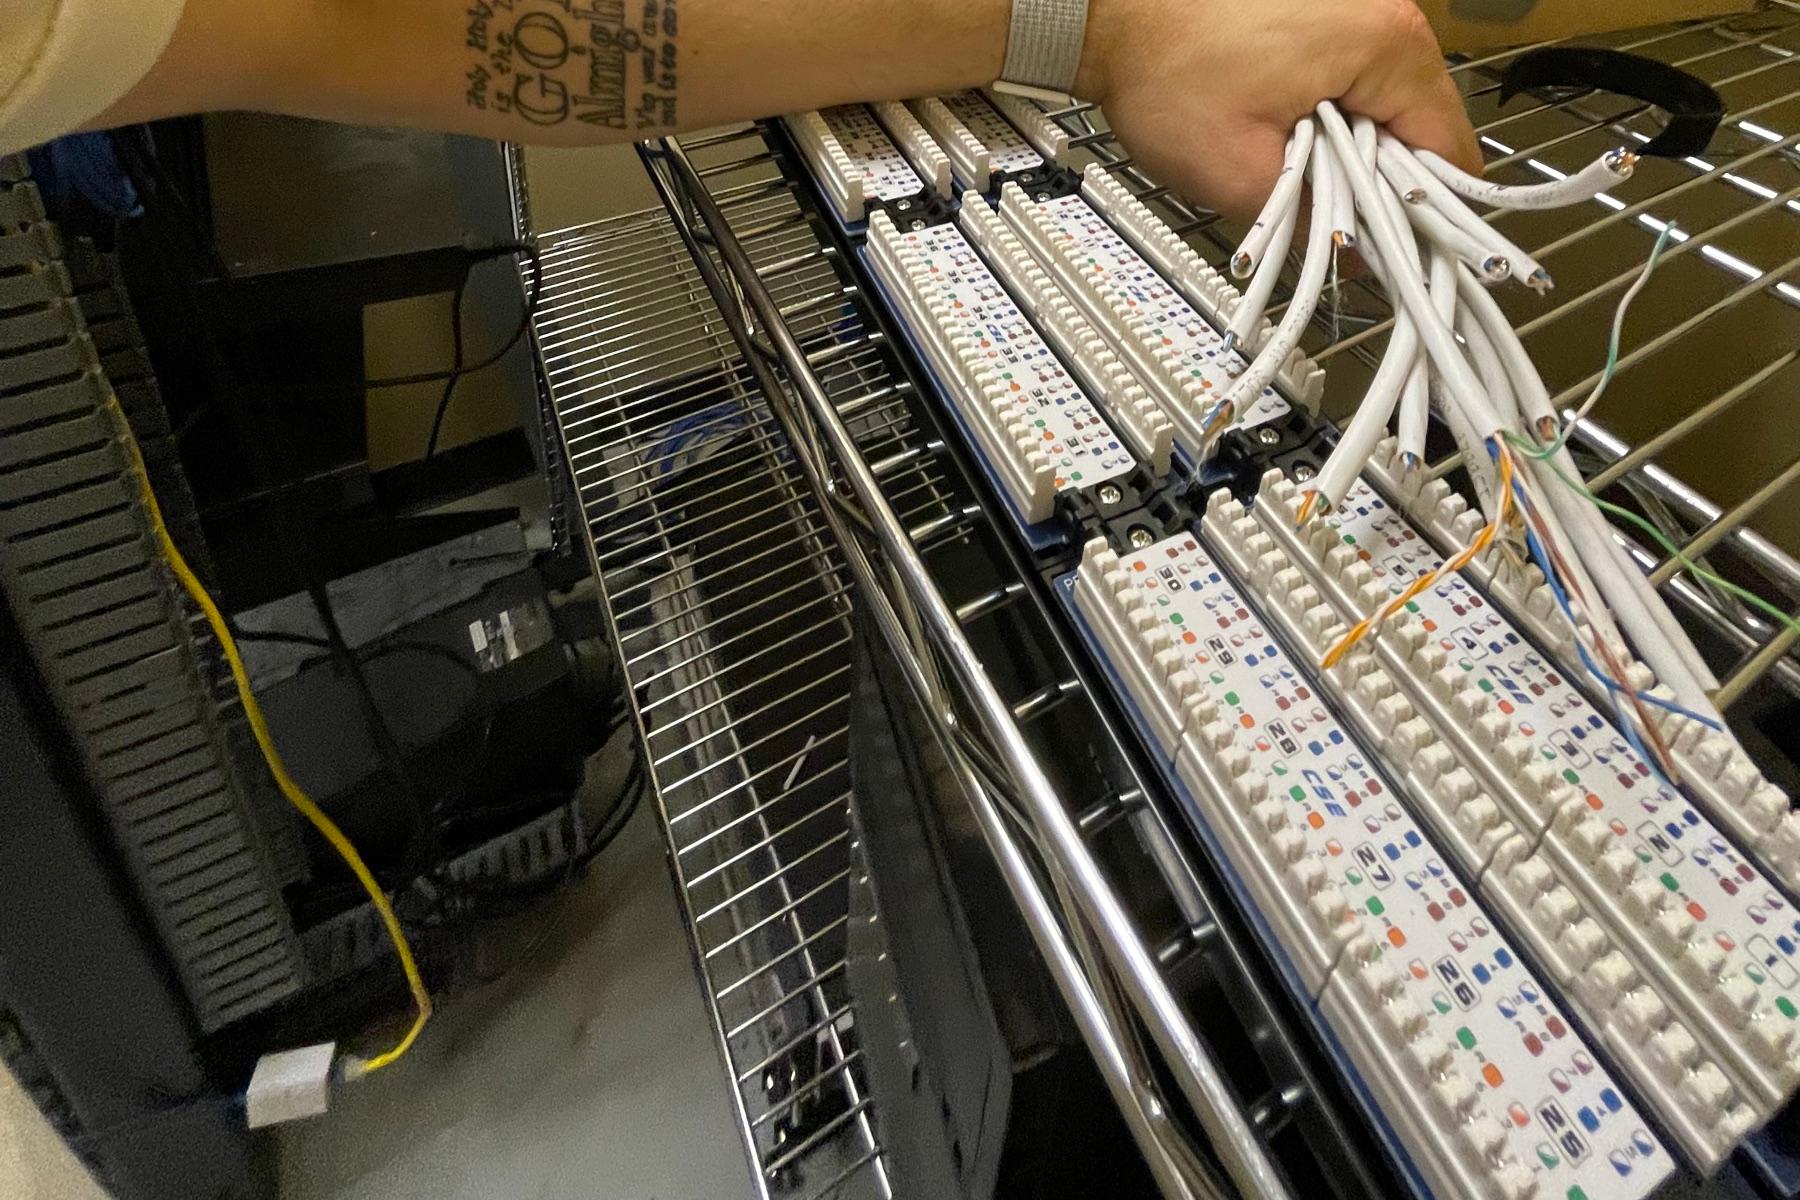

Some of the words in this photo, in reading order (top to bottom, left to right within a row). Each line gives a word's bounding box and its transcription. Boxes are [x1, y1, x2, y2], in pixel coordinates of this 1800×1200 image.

[490, 31, 515, 75] the
[466, 63, 492, 110] Holy
[491, 92, 513, 113] is
[1032, 388, 1050, 407] 32
[1159, 566, 1183, 592] 30
[1208, 637, 1234, 665] 29
[1267, 721, 1297, 755] 28
[1356, 845, 1391, 887] 27
[1437, 959, 1475, 1007] 26
[1540, 1103, 1585, 1159] 25
